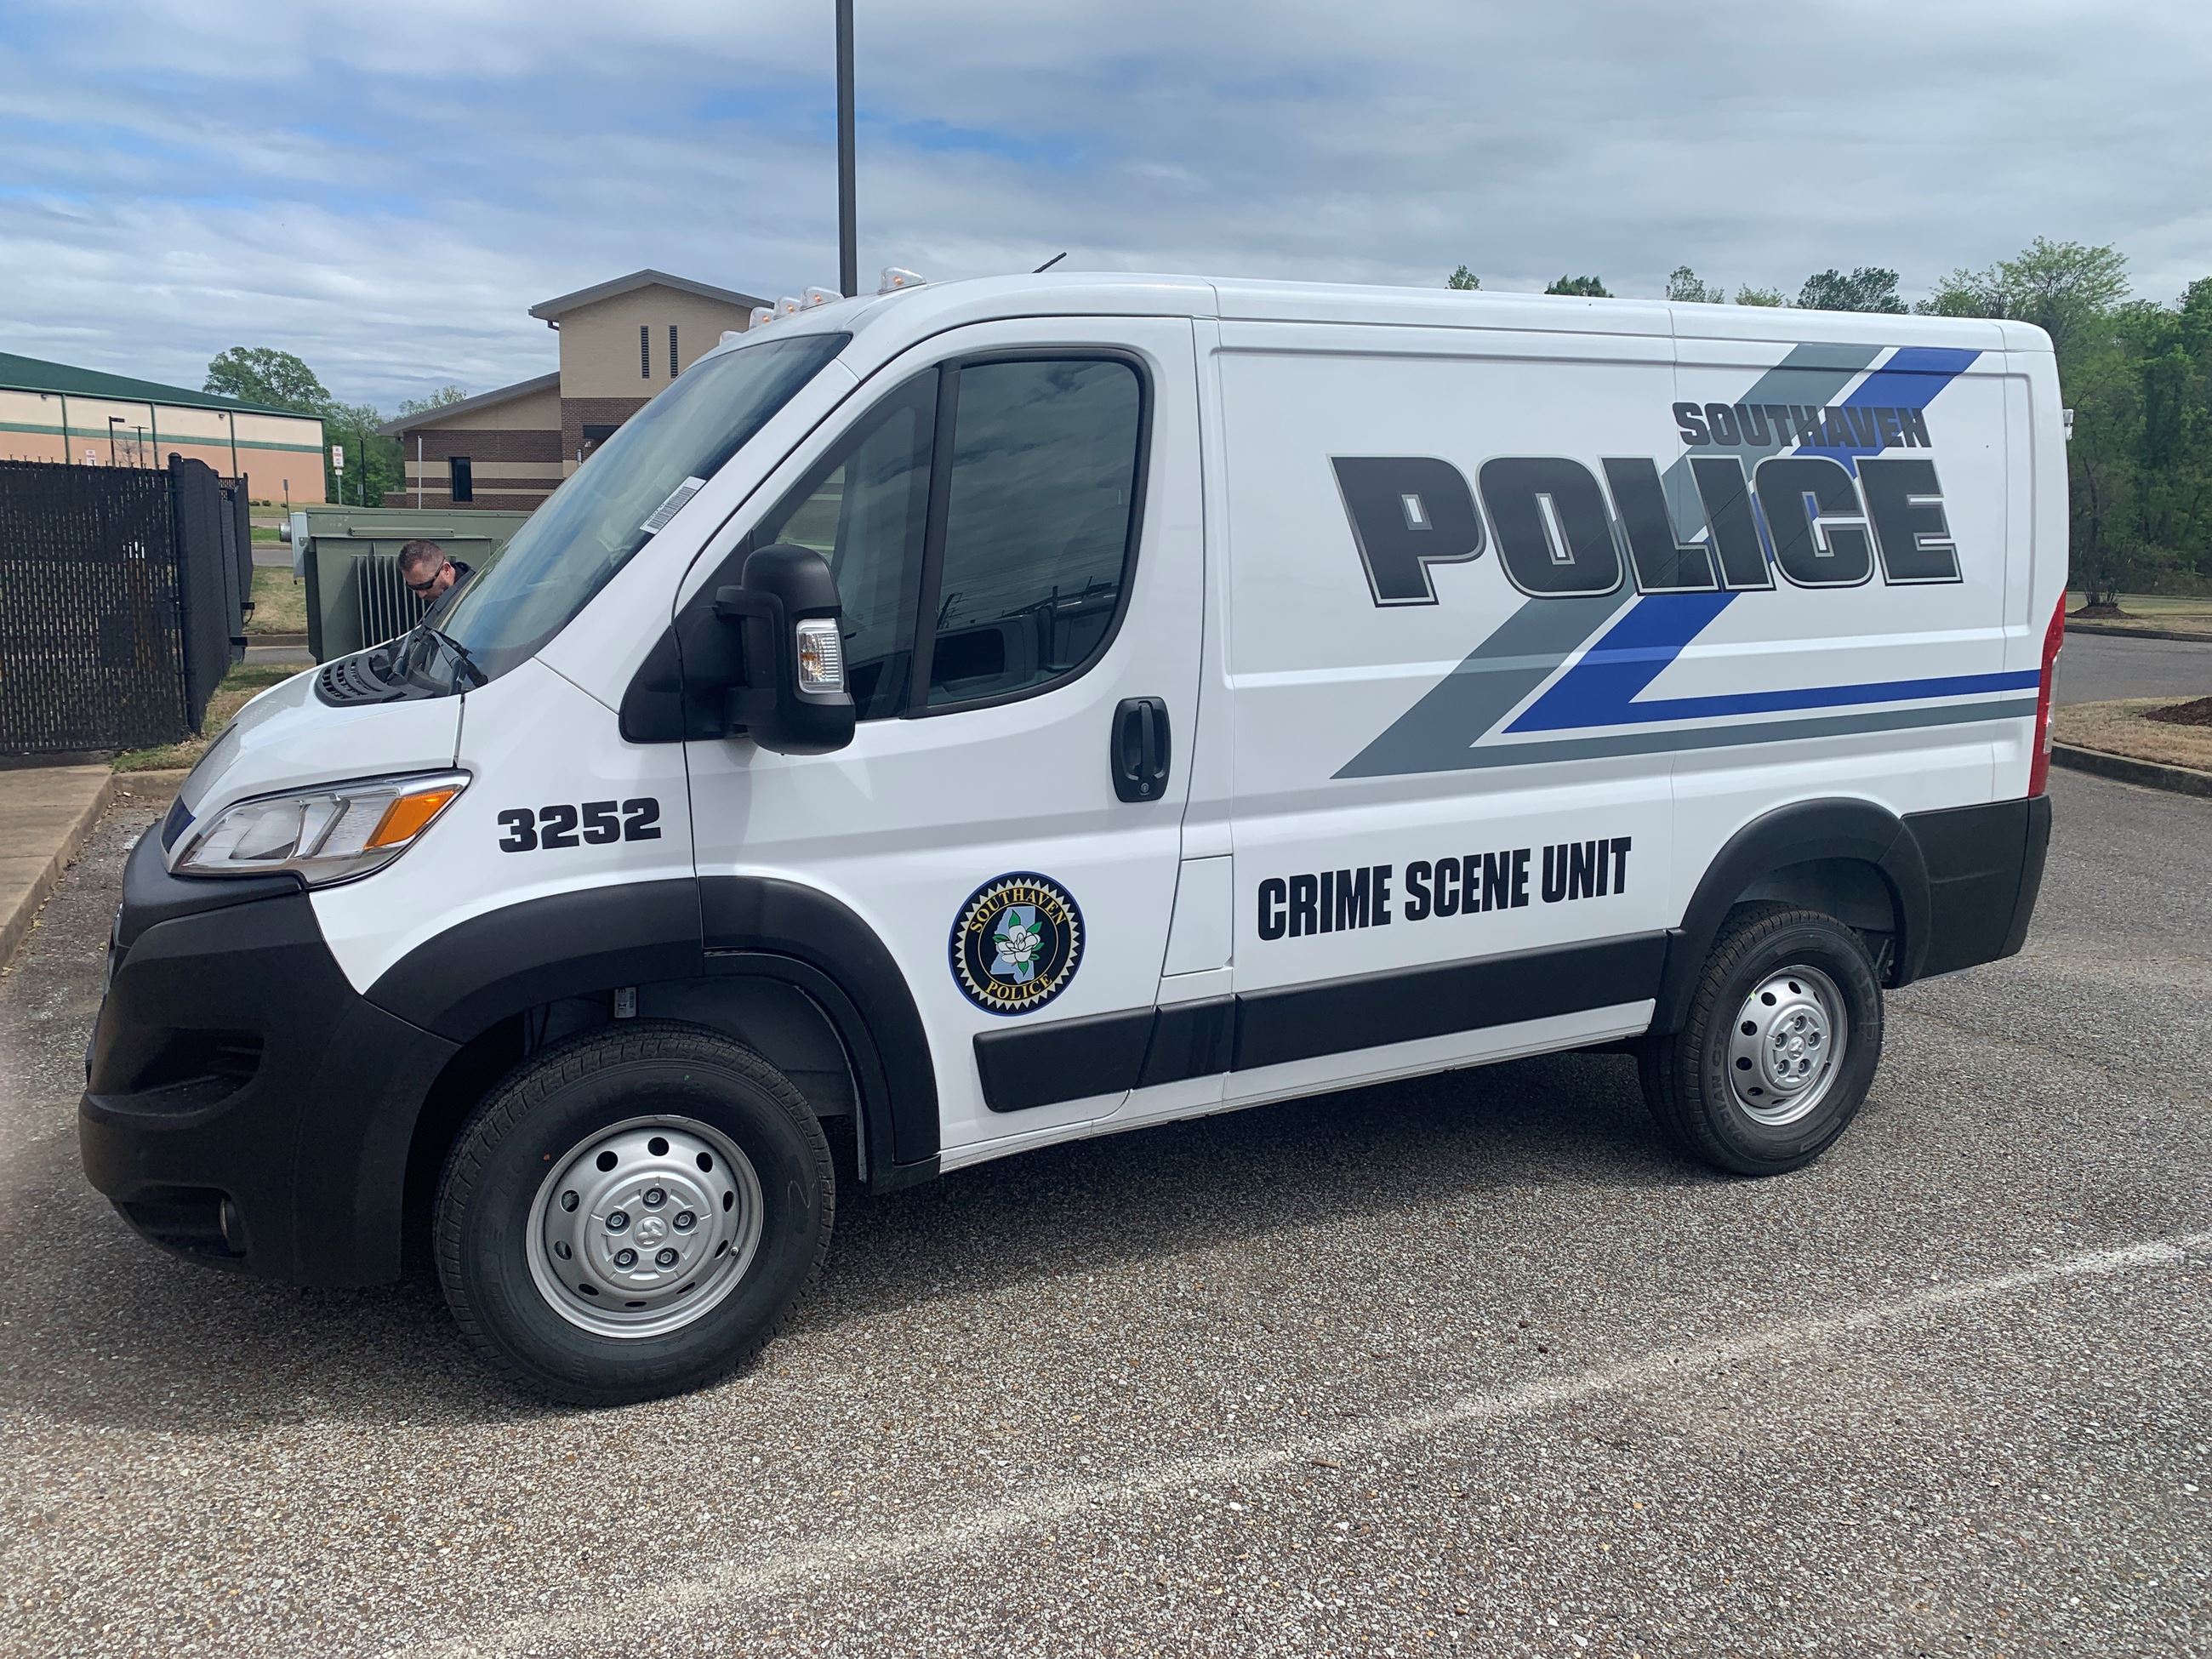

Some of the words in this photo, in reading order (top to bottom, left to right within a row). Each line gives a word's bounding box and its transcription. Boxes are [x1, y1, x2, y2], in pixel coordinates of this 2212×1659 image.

[1672, 402, 1933, 448] SOUTHAVEN
[1327, 453, 1964, 607] POLICE
[498, 797, 661, 852] 3252
[970, 887, 1066, 933] SOUTHAVEN
[1257, 864, 1393, 941] CRIME
[1404, 848, 1531, 921] SCENE
[1541, 836, 1632, 904] UNIT
[984, 973, 1052, 1001] POLICE
